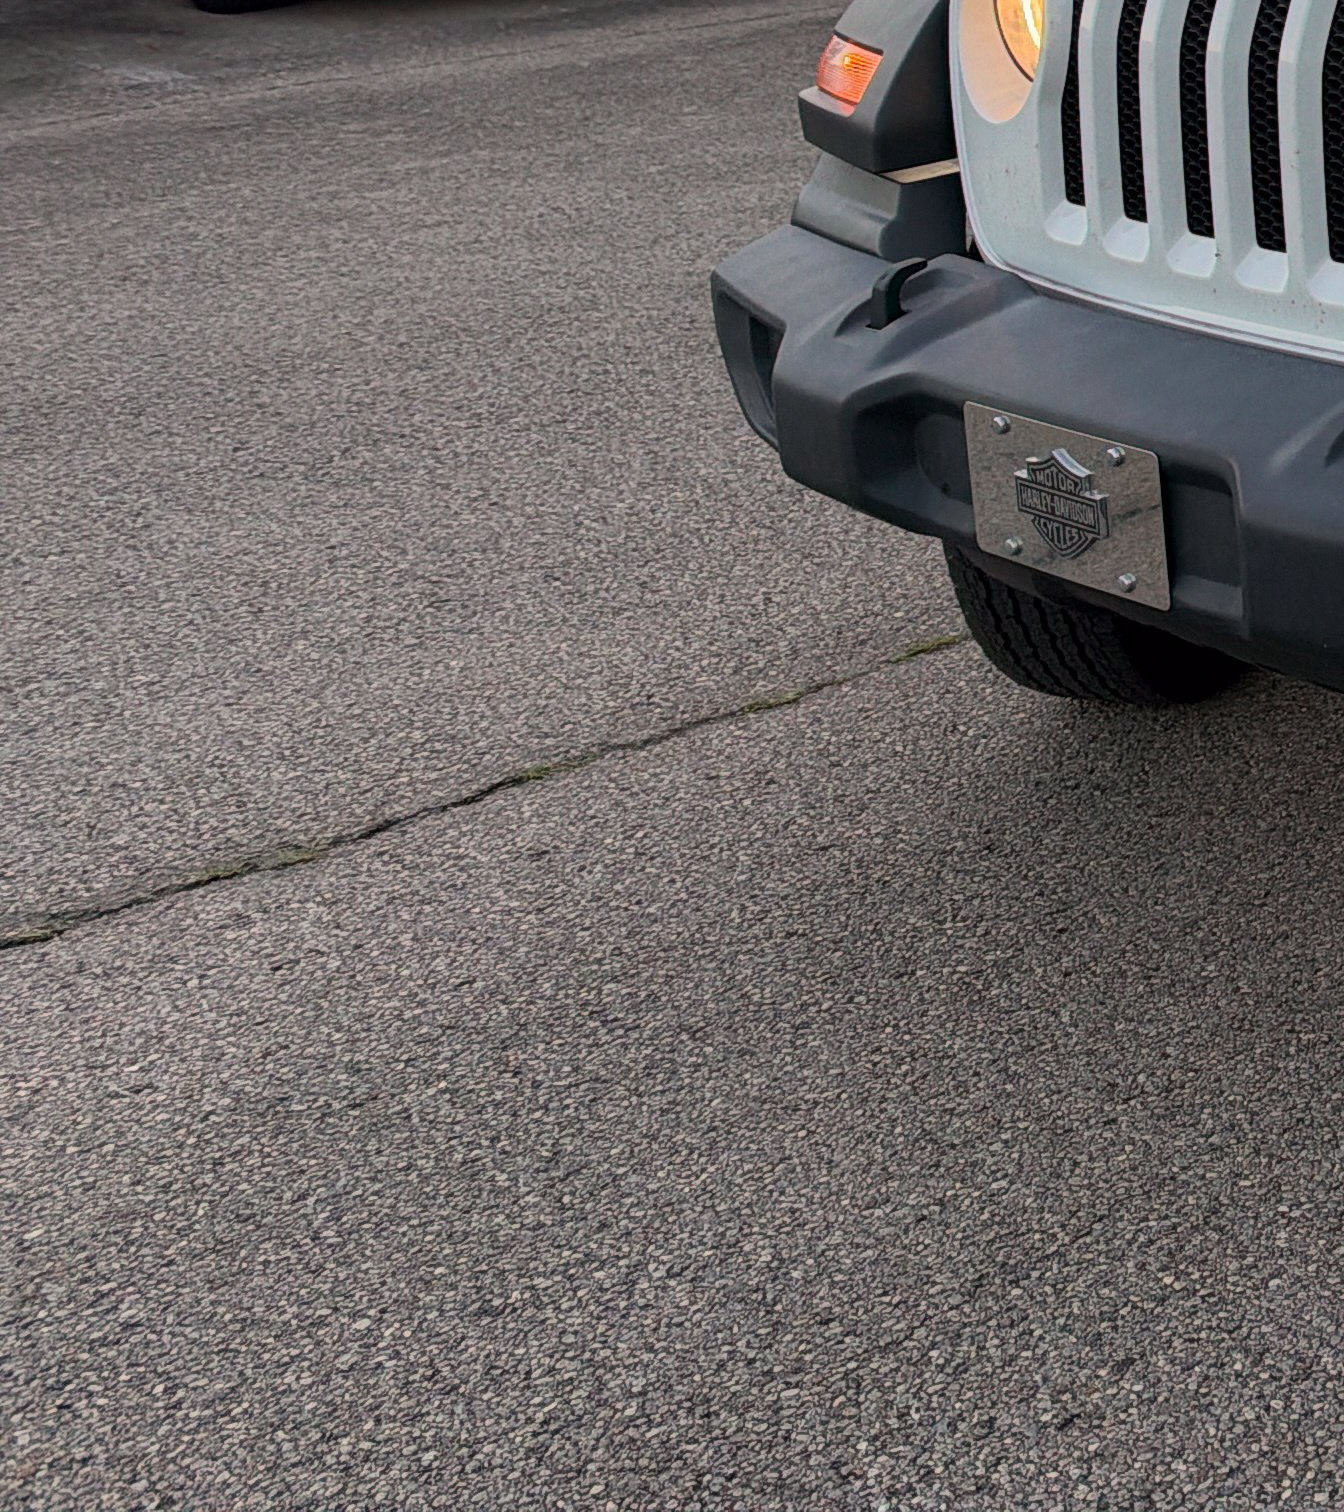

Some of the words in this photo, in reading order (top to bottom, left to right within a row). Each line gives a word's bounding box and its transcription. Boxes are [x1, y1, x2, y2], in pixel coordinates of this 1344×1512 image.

[1035, 465, 1075, 494] MOTOR
[1021, 484, 1095, 527] HARLEY-DAVIDSON
[1040, 518, 1079, 549] CYCLES
